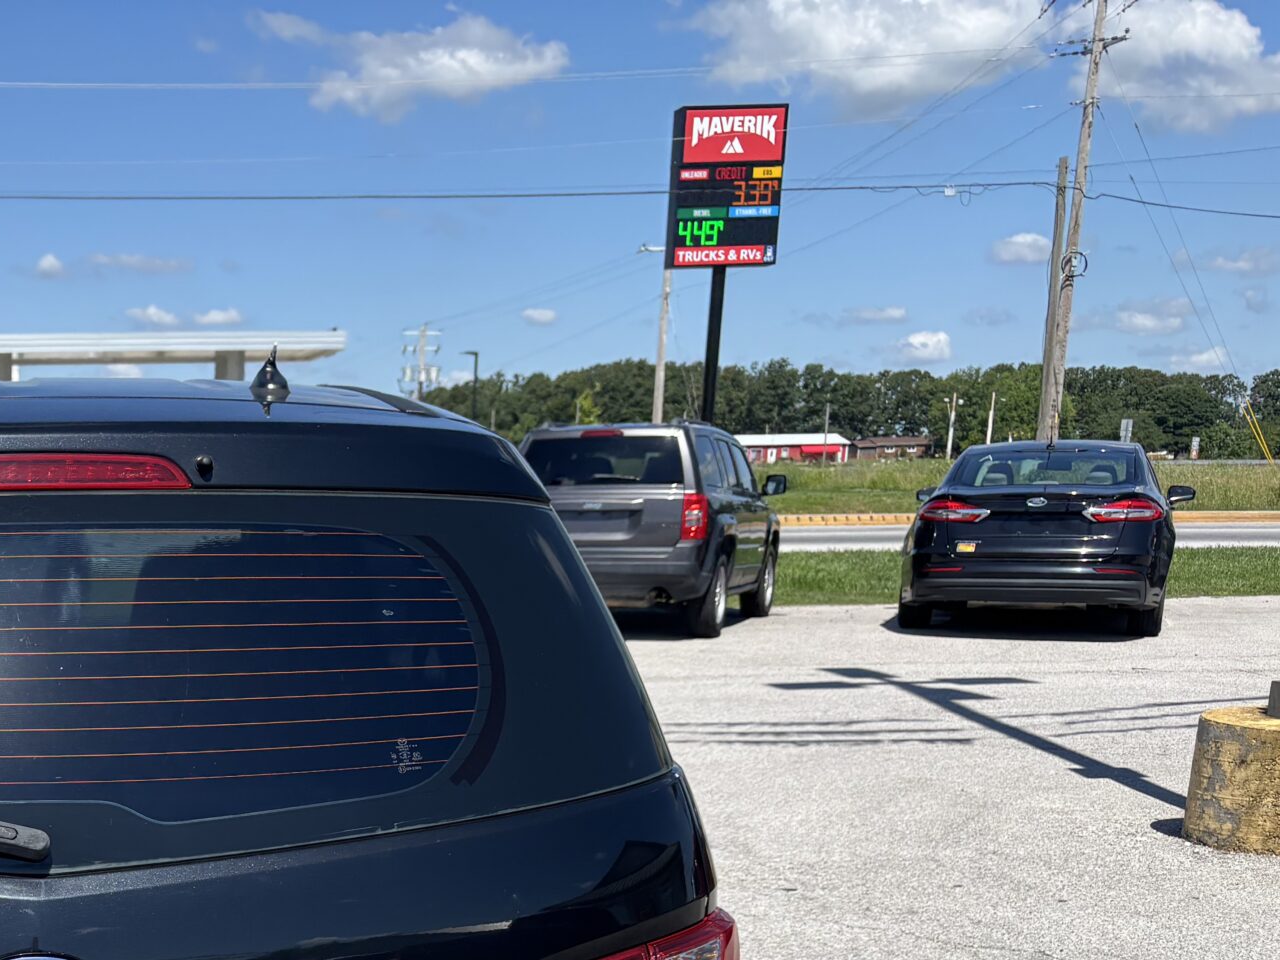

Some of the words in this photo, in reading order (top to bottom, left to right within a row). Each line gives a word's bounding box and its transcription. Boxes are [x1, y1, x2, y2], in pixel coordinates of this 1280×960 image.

[691, 115, 777, 147] MAVERIK
[715, 167, 746, 179] CREDIT
[677, 247, 725, 262] TRUCKS
[727, 248, 737, 261] &
[740, 247, 761, 260] RVs
